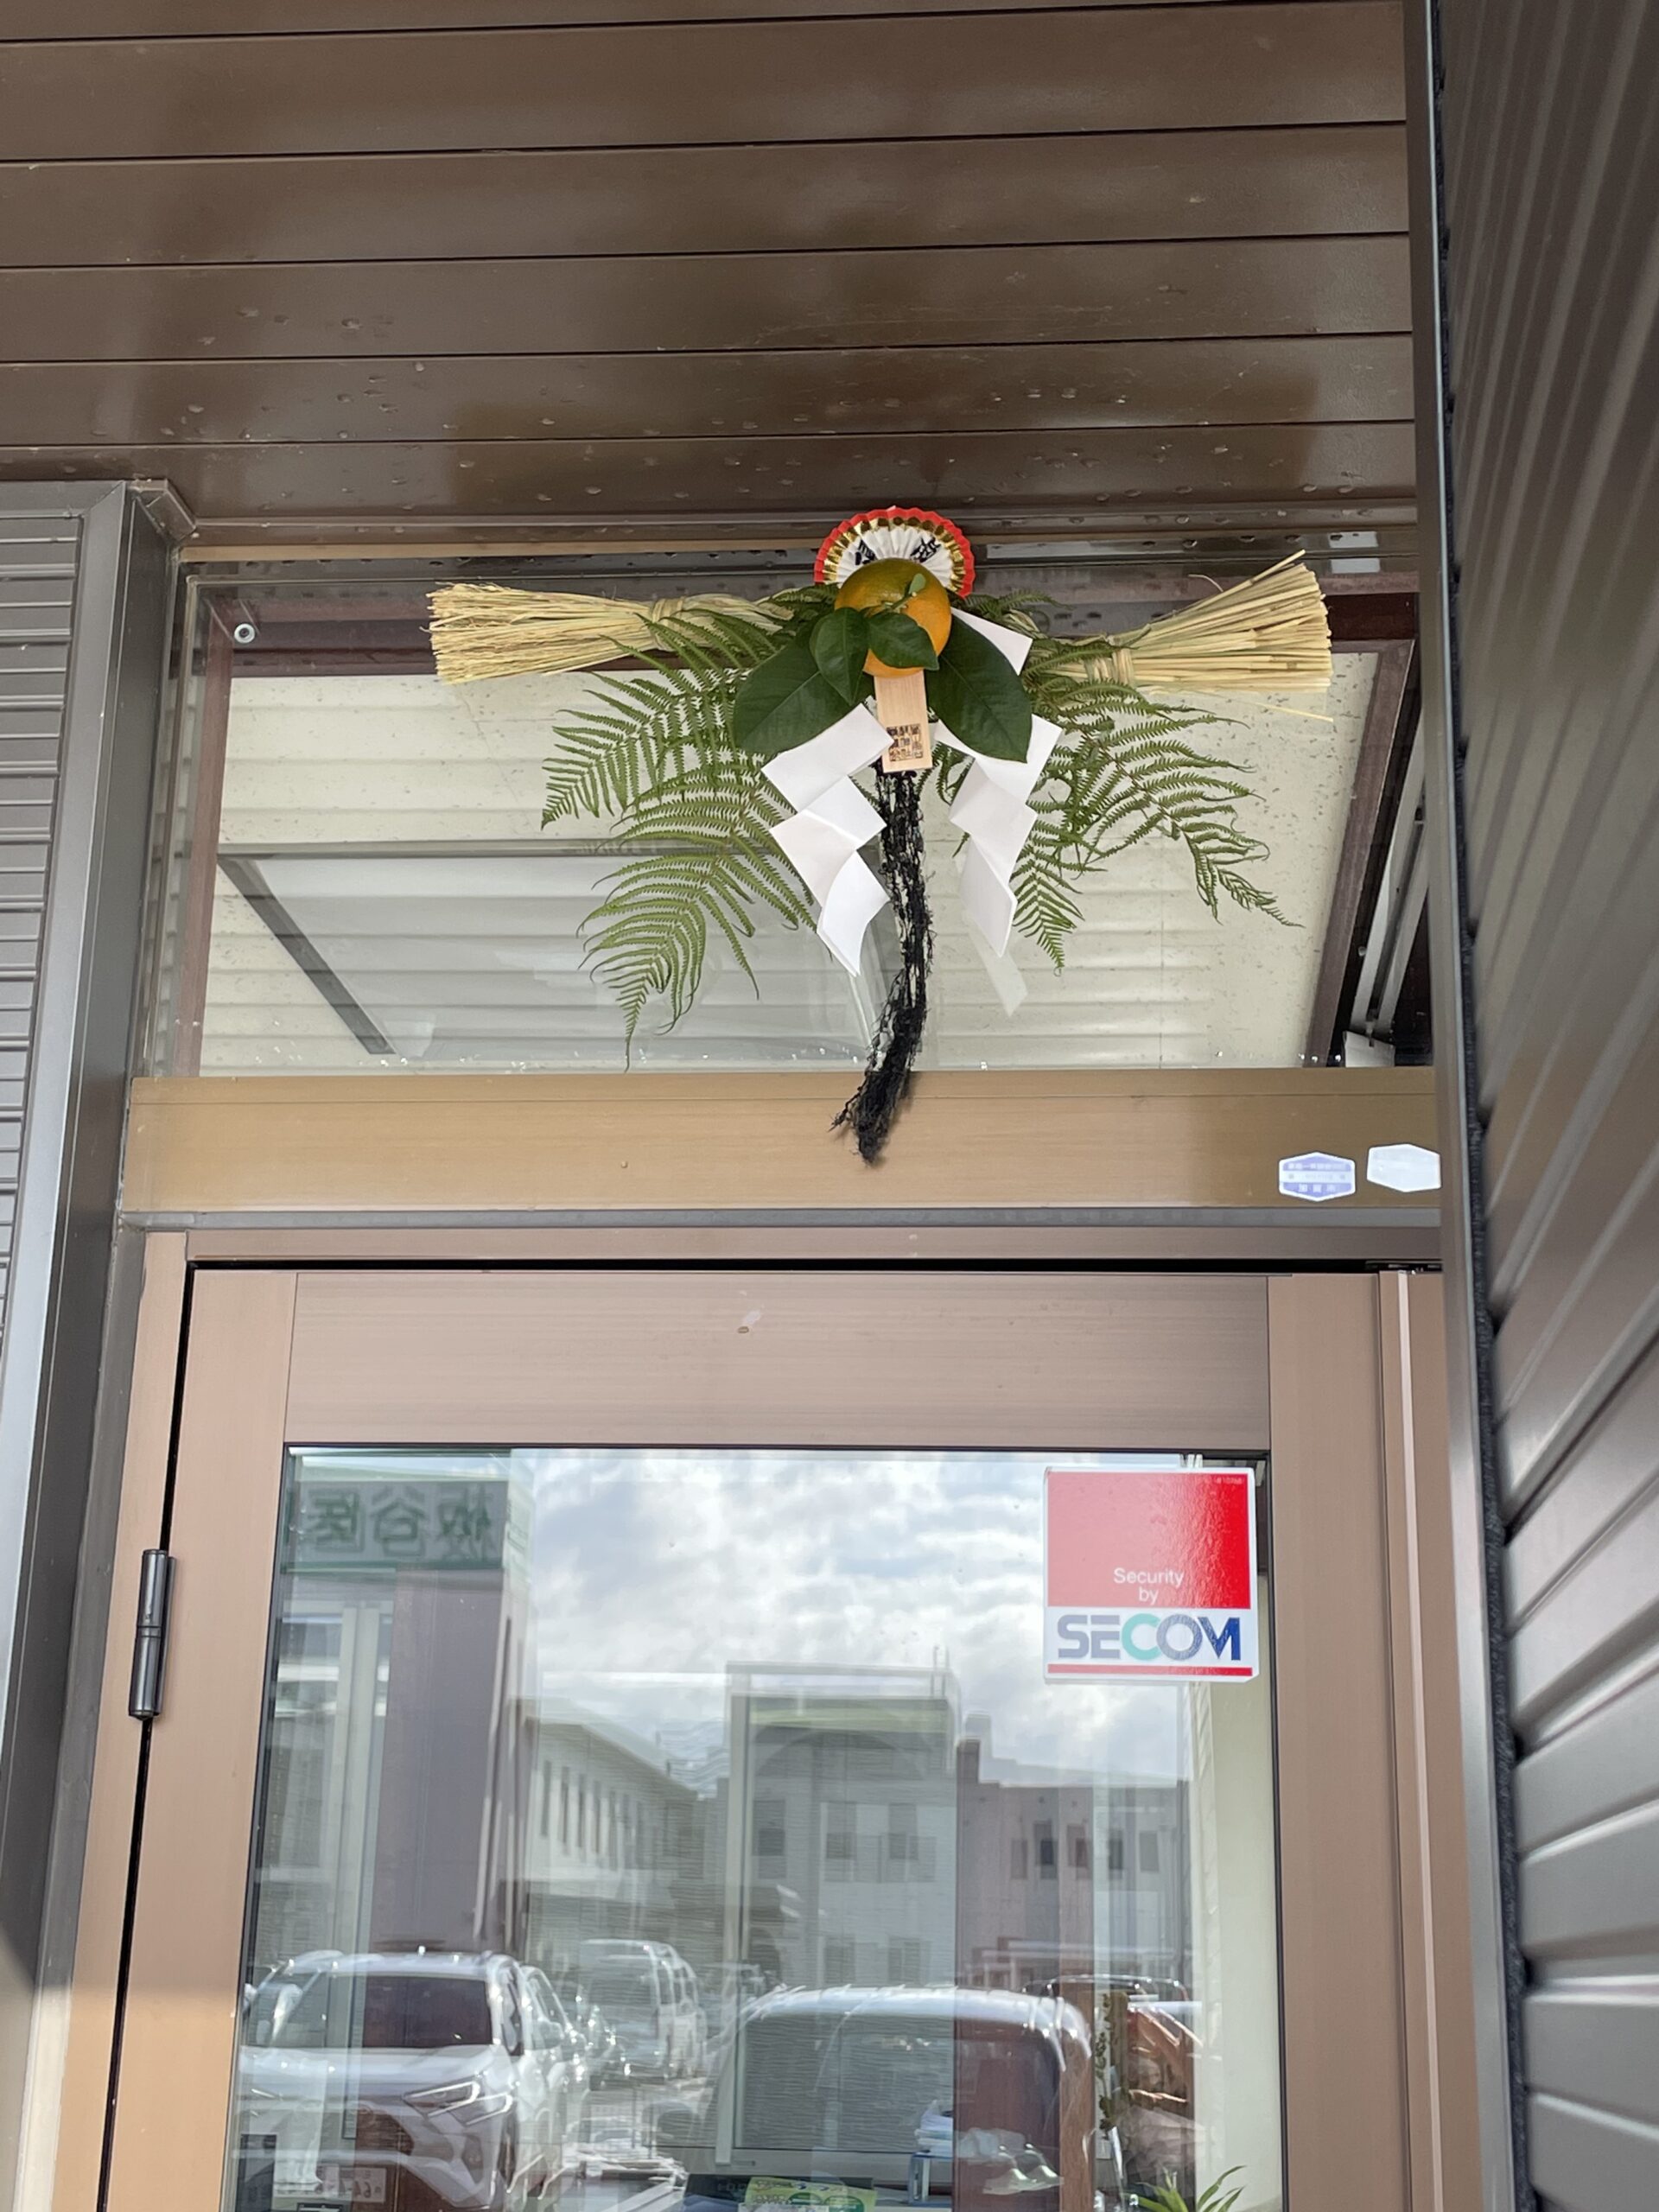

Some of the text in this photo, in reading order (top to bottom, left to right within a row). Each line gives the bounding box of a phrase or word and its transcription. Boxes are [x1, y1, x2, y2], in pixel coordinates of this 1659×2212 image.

[1113, 1567, 1185, 1589] Security
[1138, 1586, 1159, 1605] by
[1057, 1612, 1242, 1662] SECOM
